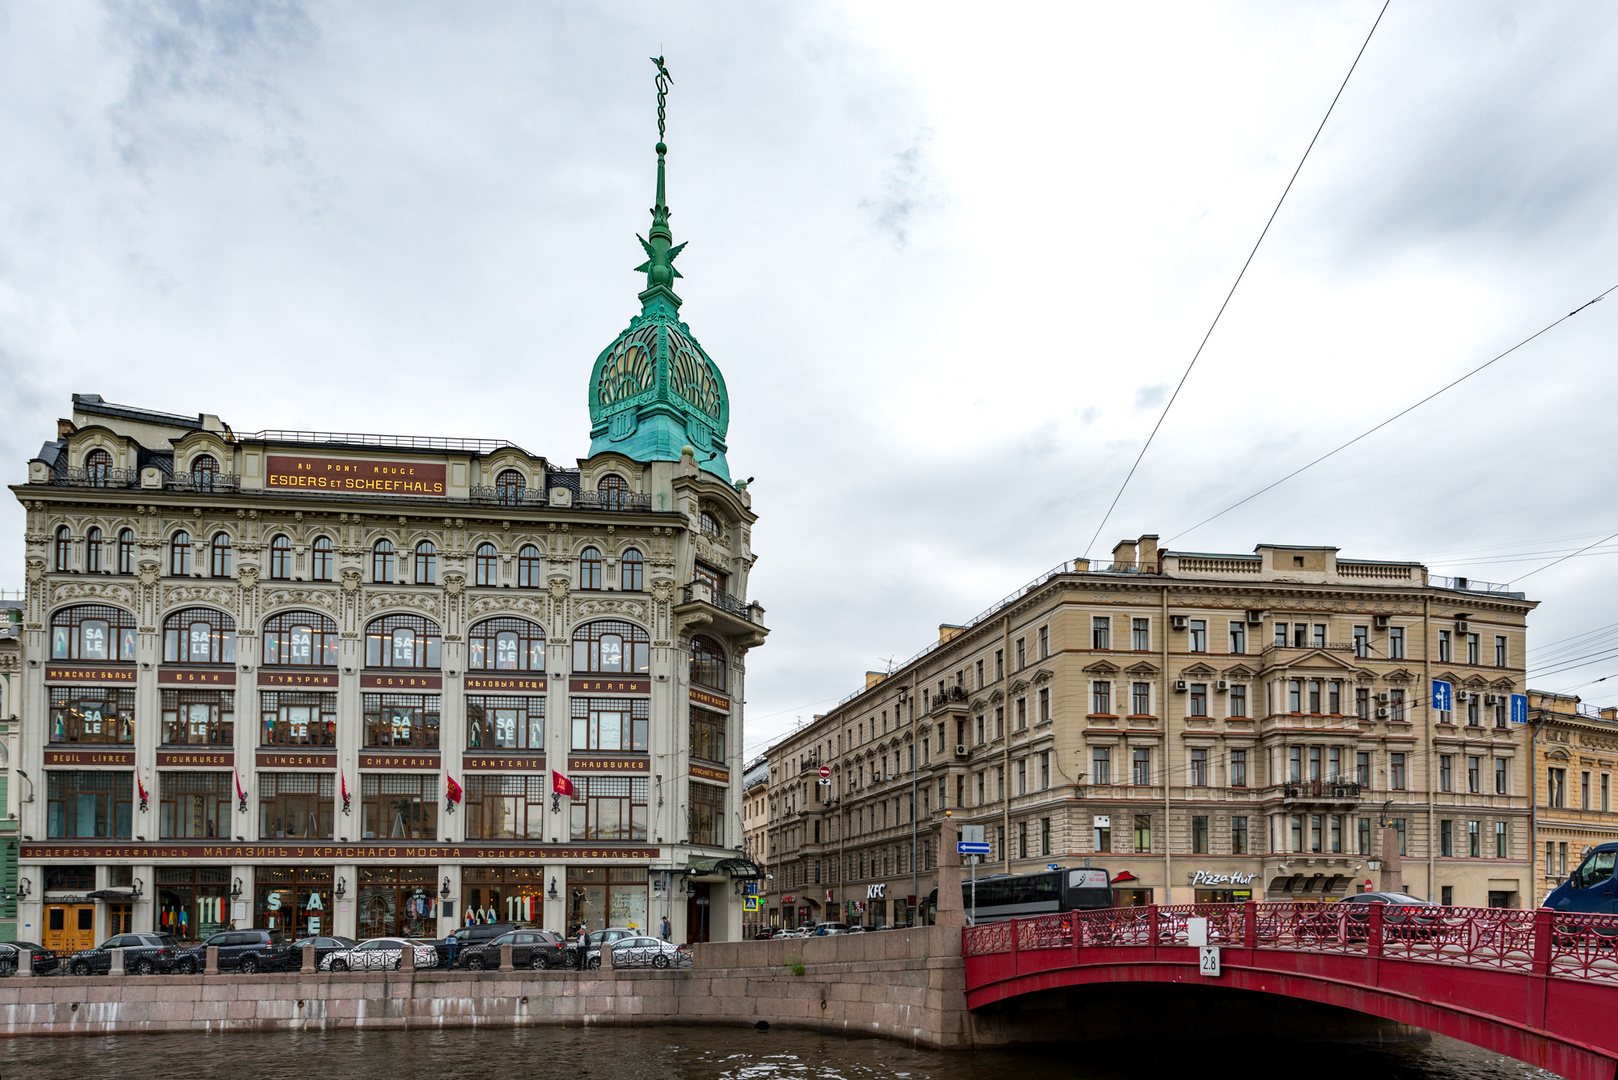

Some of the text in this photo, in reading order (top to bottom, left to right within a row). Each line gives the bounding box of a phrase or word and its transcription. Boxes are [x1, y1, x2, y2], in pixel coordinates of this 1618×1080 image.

[327, 464, 358, 472] PONT
[374, 466, 415, 475] ROUGE
[270, 474, 443, 493] ESDERS ET SCHEEFHALS
[50, 670, 96, 678] МУЖСКОЕ
[176, 673, 219, 681] ЮБКИ
[270, 675, 329, 683] ТУЖУРКИ
[377, 678, 427, 686] ОБУВЬ
[583, 682, 637, 690] ШЛЯПЫ
[366, 758, 433, 766] CHAPEAUX
[204, 848, 288, 858] МАГАЗИНЪ
[314, 848, 397, 858] КРАСНАГО
[406, 848, 461, 858] МОСТА
[478, 850, 547, 858] ЭСДЕРСЪ
[562, 850, 650, 858] СХЕФАЛЬСЪ
[1192, 870, 1256, 885] Pizza Hut
[867, 884, 886, 899] KFC
[198, 896, 226, 923] 110
[506, 896, 535, 922] 110
[1203, 956, 1216, 970] 2.8
